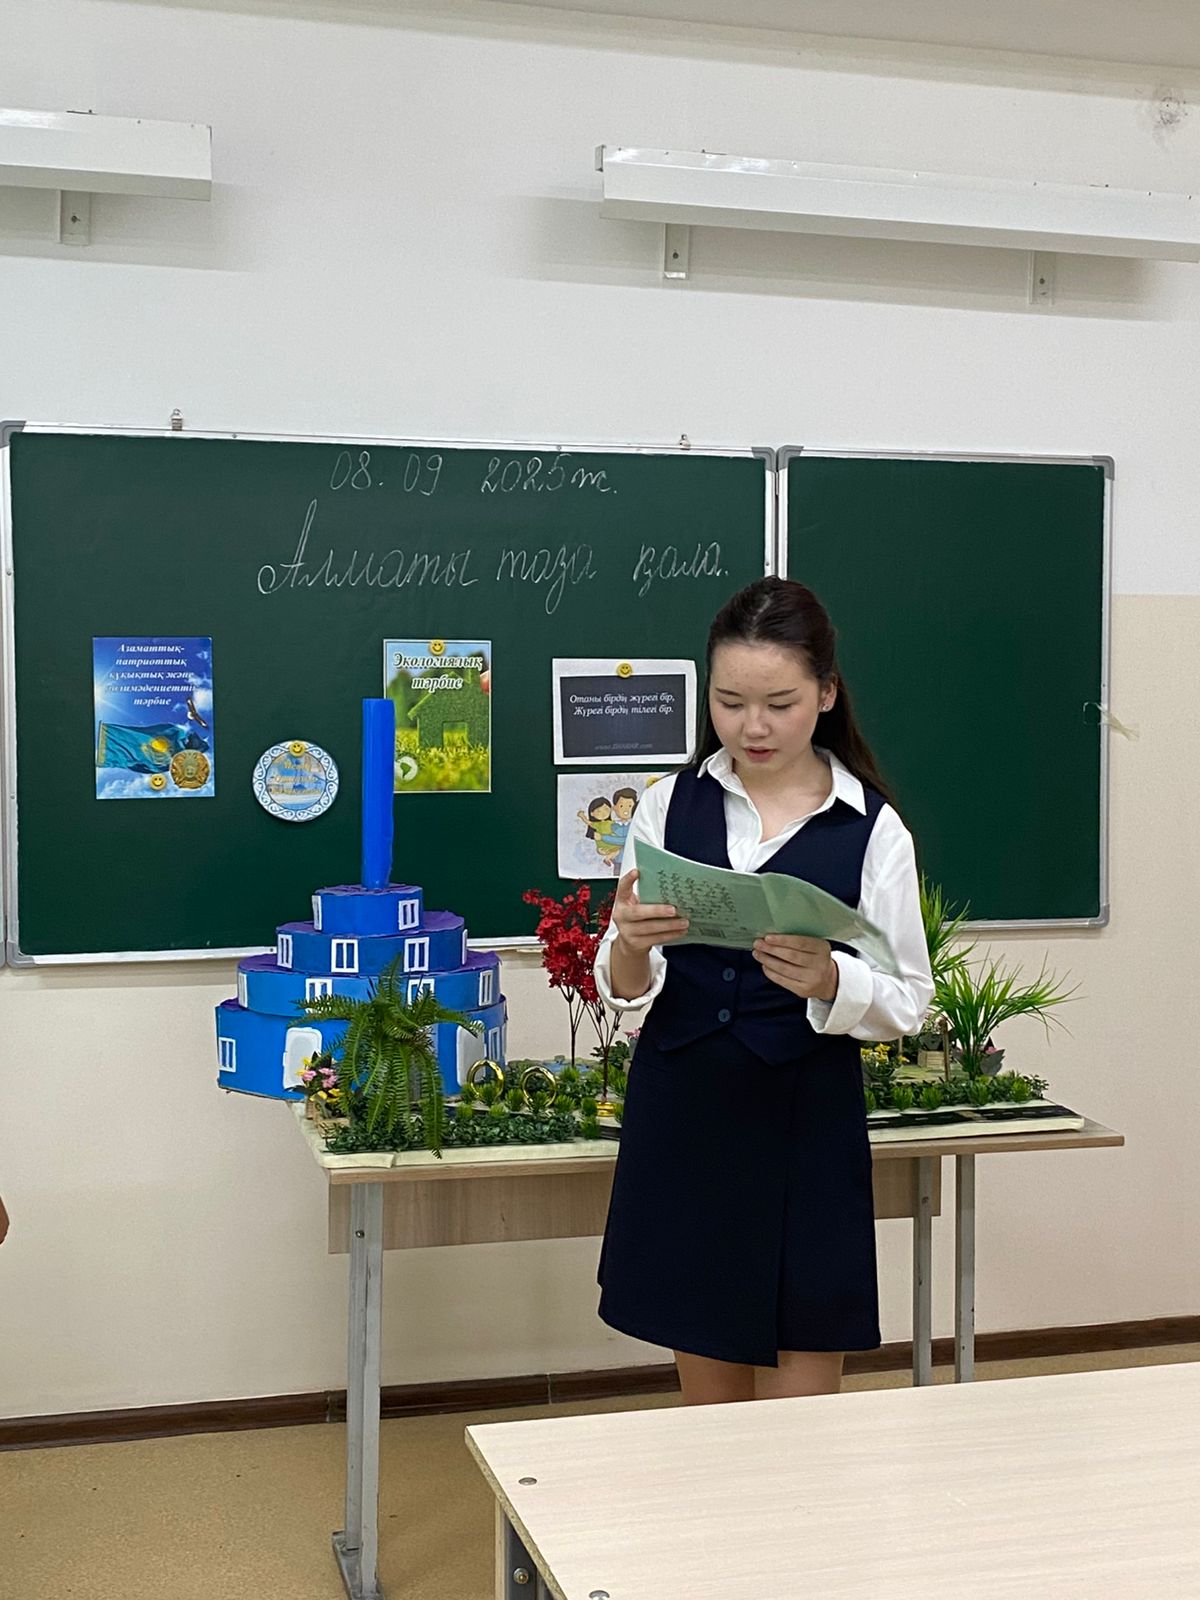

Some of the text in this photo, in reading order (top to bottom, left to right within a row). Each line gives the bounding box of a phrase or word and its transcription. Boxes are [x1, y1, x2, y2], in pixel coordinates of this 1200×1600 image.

[330, 450, 384, 490] 08.
[403, 453, 443, 496] 09
[257, 498, 478, 594] Алматы
[496, 543, 598, 615] таза
[118, 643, 185, 653] Азаматтық-
[115, 658, 188, 668] патриоттық
[393, 653, 483, 671] Экологиялық
[165, 671, 194, 680] және
[411, 674, 463, 694] тәрбие
[133, 696, 172, 707] тәрбие
[569, 694, 602, 704] Отаны
[630, 704, 657, 714] тілегі
[658, 704, 674, 715] бір.
